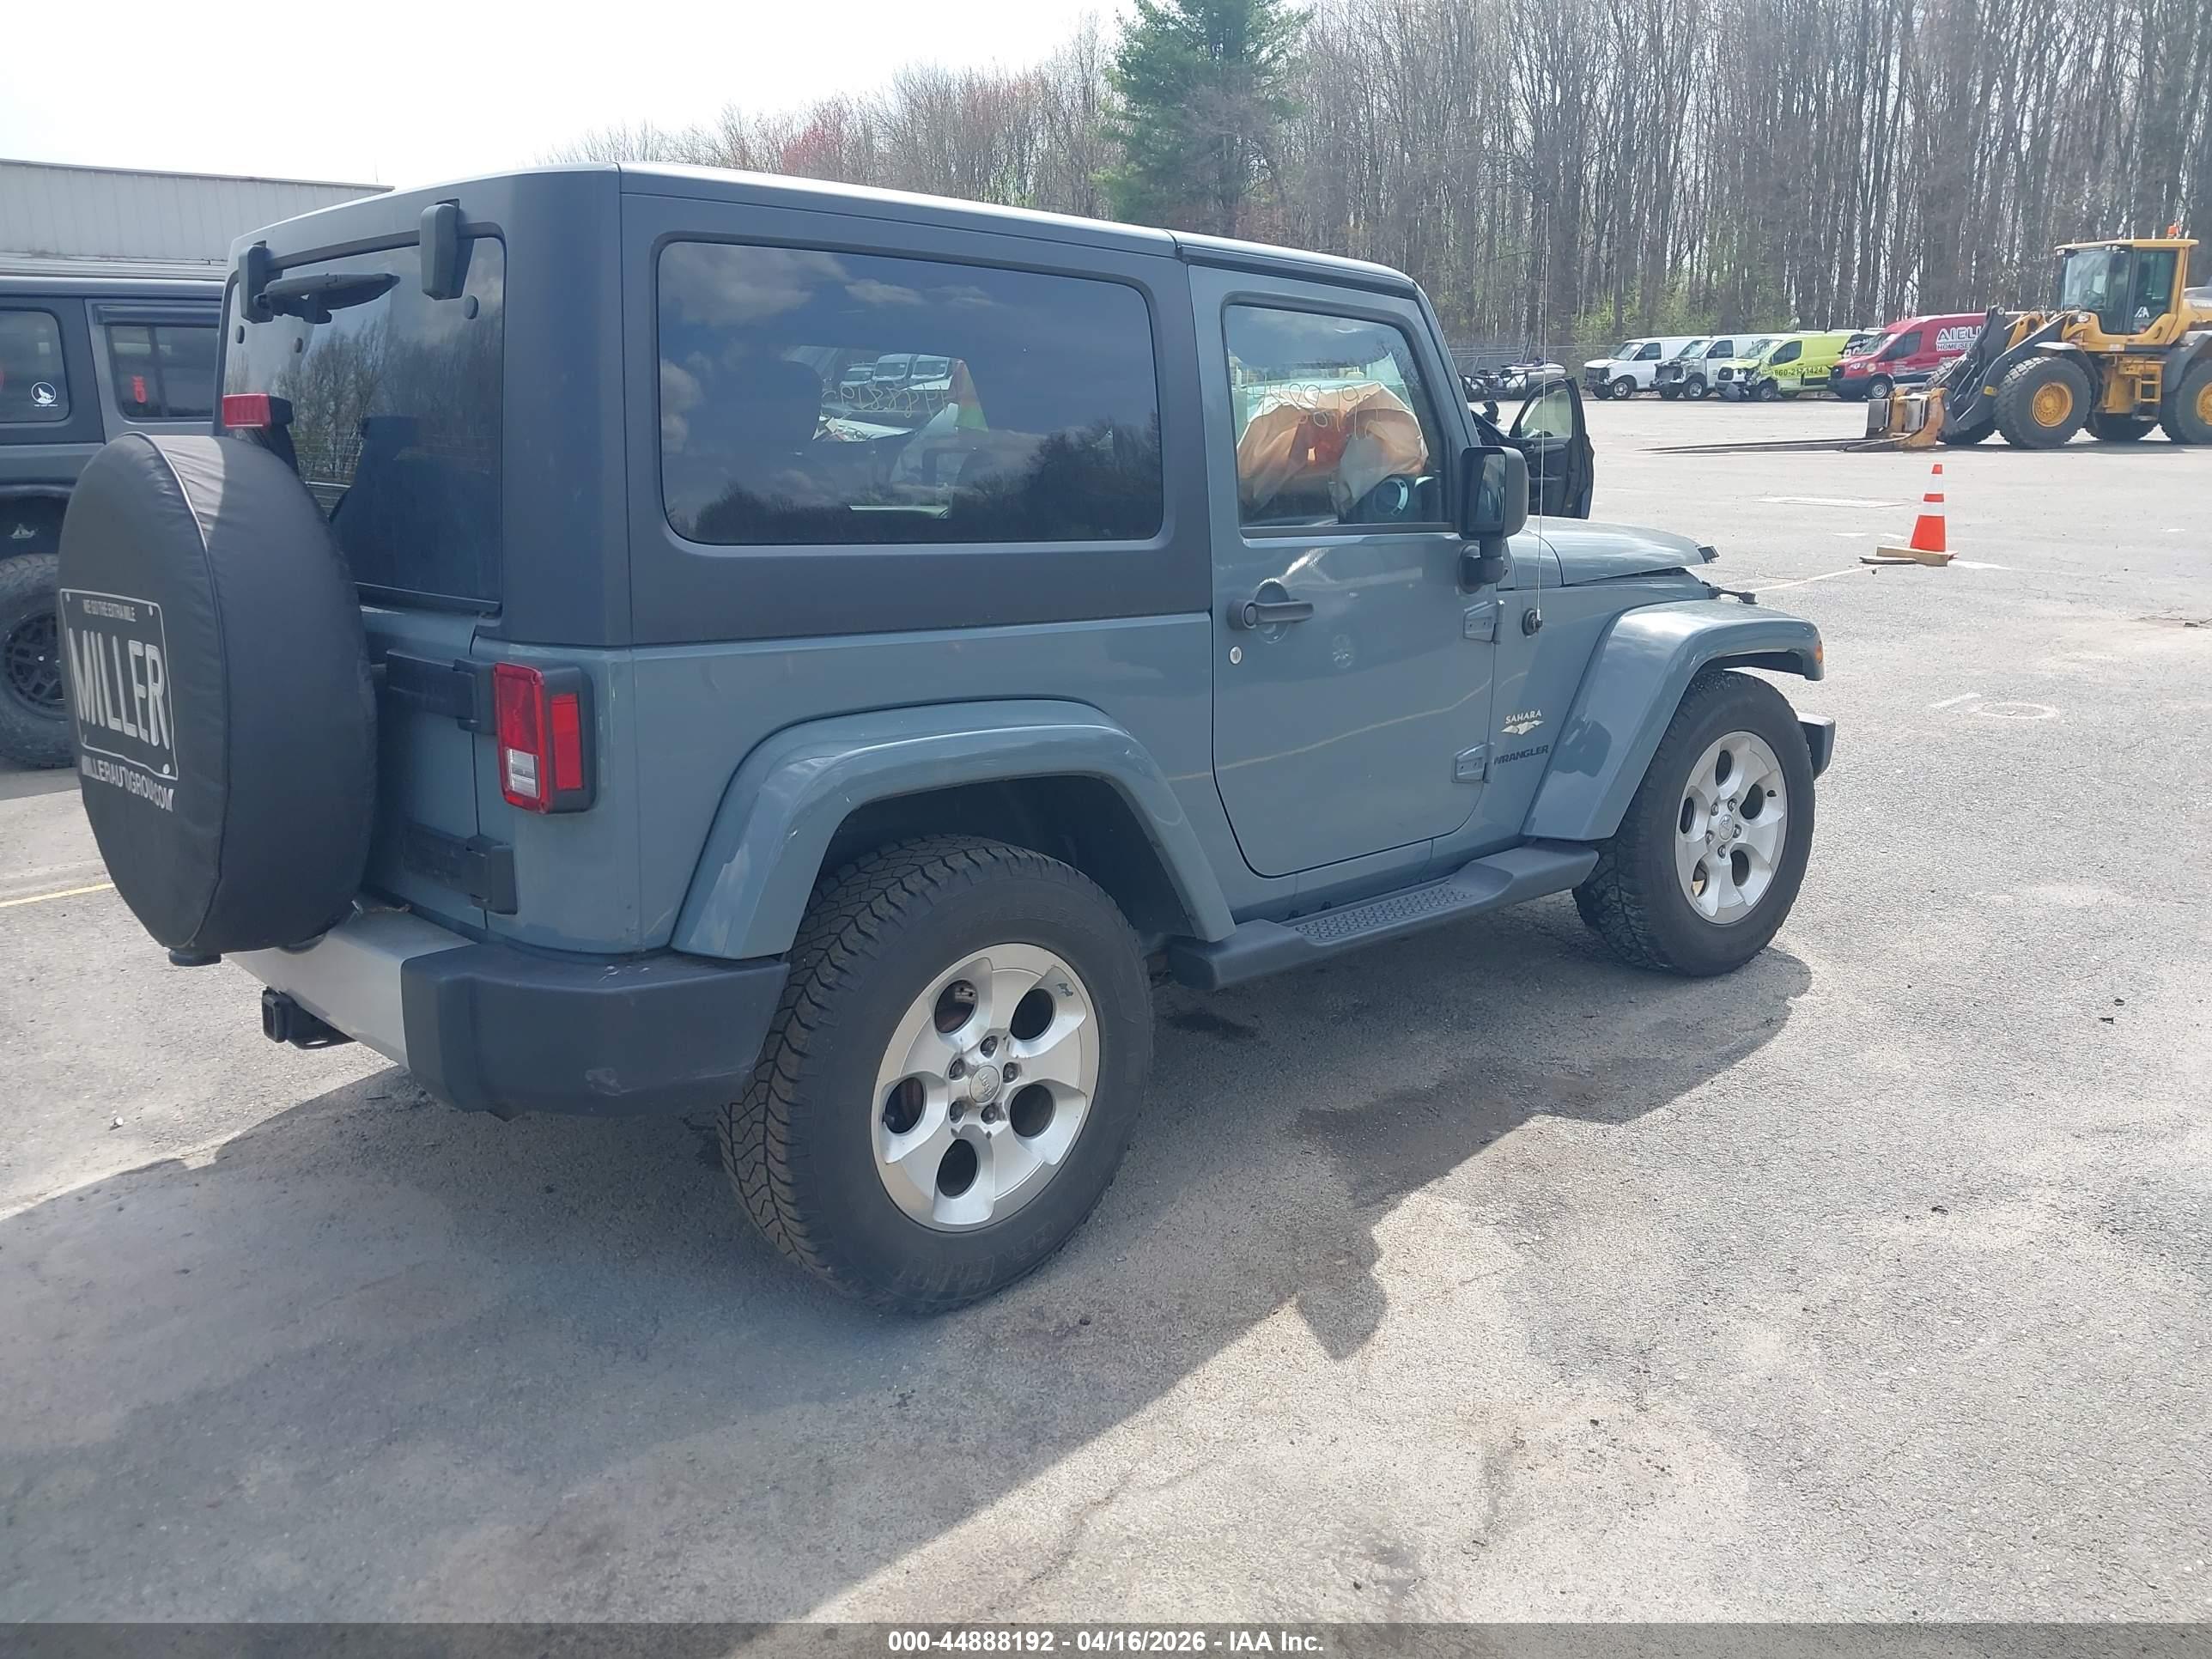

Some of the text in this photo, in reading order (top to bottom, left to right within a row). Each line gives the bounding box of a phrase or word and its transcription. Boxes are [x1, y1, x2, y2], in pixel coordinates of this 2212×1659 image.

[68, 627, 170, 750] MILLER
[1505, 708, 1542, 724] SAHARA
[1493, 744, 1549, 765] WRANGLER
